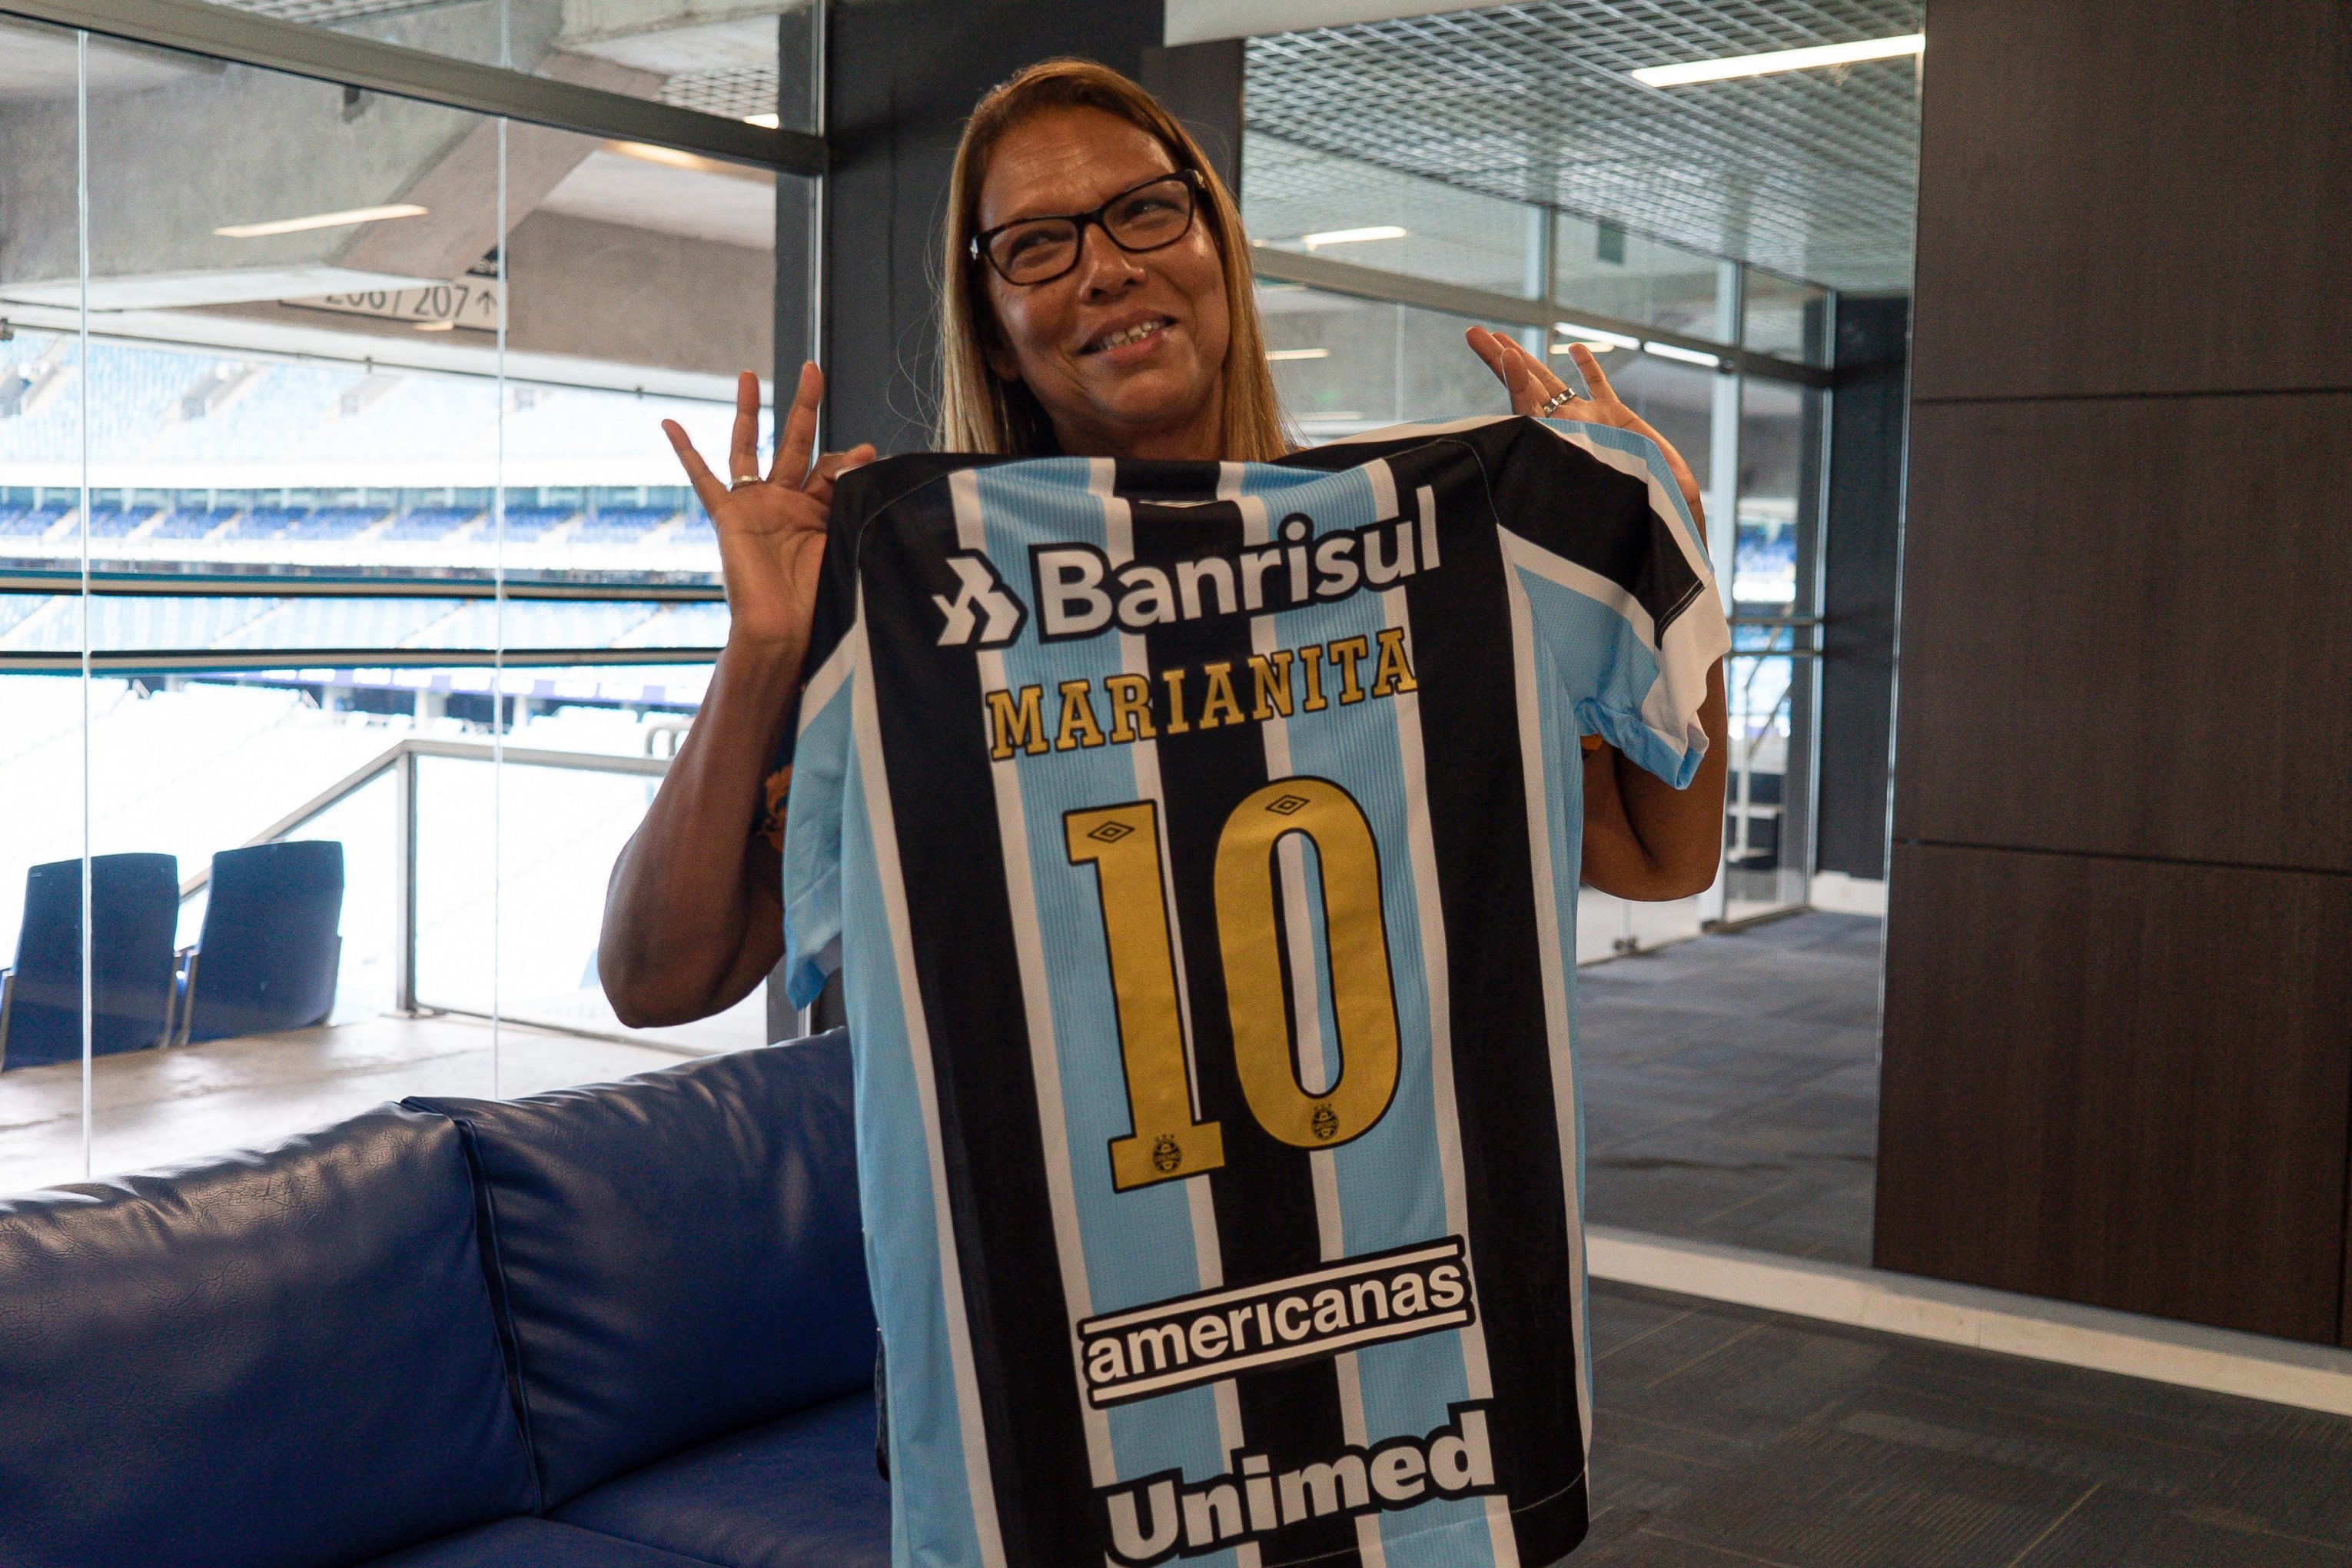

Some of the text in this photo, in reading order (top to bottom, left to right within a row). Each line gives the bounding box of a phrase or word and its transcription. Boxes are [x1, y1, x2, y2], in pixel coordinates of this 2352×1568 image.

[414, 283, 470, 319] 207
[1034, 484, 1442, 636] Banrisul
[985, 627, 1418, 762] MARIANITA
[1062, 775, 1403, 1194] 10
[1087, 1264, 1466, 1384] americanas
[1107, 1410, 1495, 1561] Unimed
